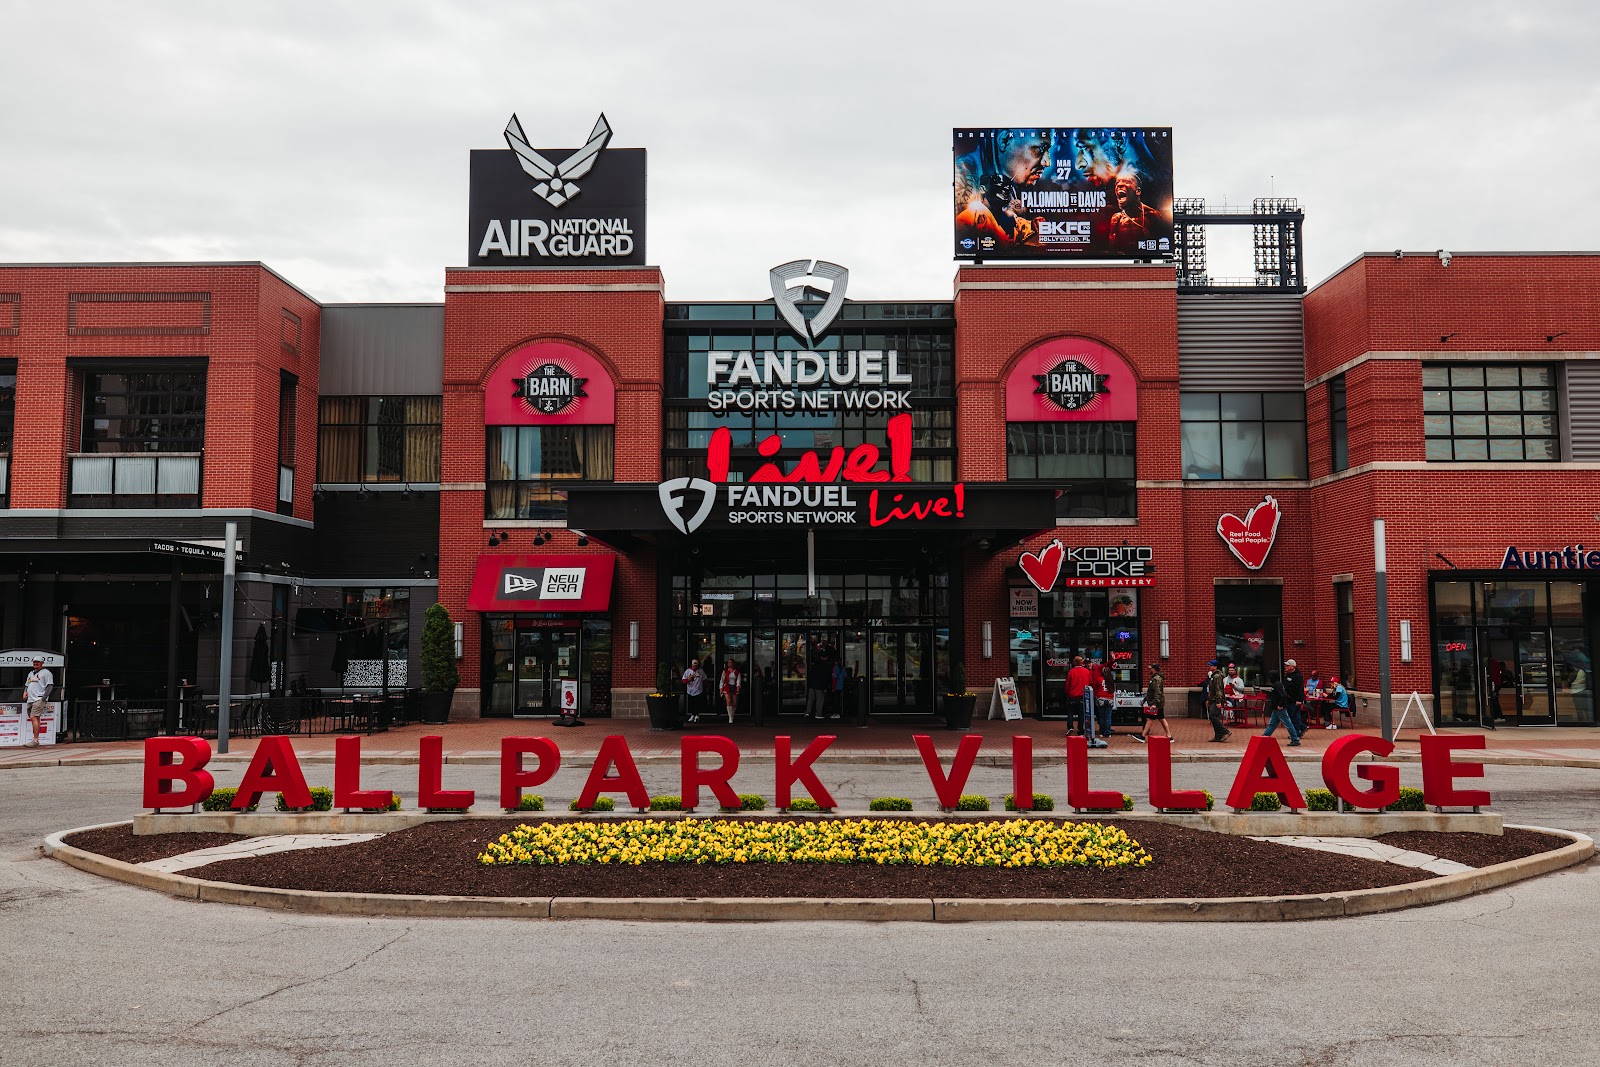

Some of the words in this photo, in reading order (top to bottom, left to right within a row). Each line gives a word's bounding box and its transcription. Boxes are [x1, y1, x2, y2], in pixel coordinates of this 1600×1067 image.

[1056, 168, 1071, 180] 27
[1021, 191, 1070, 208] PALOMINO
[1078, 191, 1107, 208] DAVIS
[1039, 221, 1090, 235] BKFC
[478, 219, 550, 258] AIR
[550, 218, 633, 235] NATIONAL
[549, 235, 634, 257] GUARD
[543, 368, 556, 376] THE
[707, 349, 912, 385] FANDUEL
[1065, 364, 1076, 372] THE
[529, 377, 570, 396] BARN
[1051, 373, 1092, 393] BARN
[707, 390, 796, 409] SPORTS
[801, 390, 912, 409] NETWORK
[728, 486, 857, 507] FANDUEL
[868, 482, 966, 528] Live!
[728, 511, 784, 524] SPORTS
[787, 511, 857, 524] NETWORK
[153, 542, 175, 552] TACOS
[180, 546, 206, 556] TEQUILA
[1067, 547, 1153, 561] KOIBITO
[1500, 544, 1600, 569] Auntie
[1076, 561, 1145, 576] POKE
[549, 574, 579, 583] NEW
[547, 583, 577, 593] ERA
[1445, 641, 1467, 652] OPEN
[1114, 650, 1133, 661] OPEN
[143, 736, 837, 810] BALLPARK
[912, 735, 1491, 809] VILLAGE
